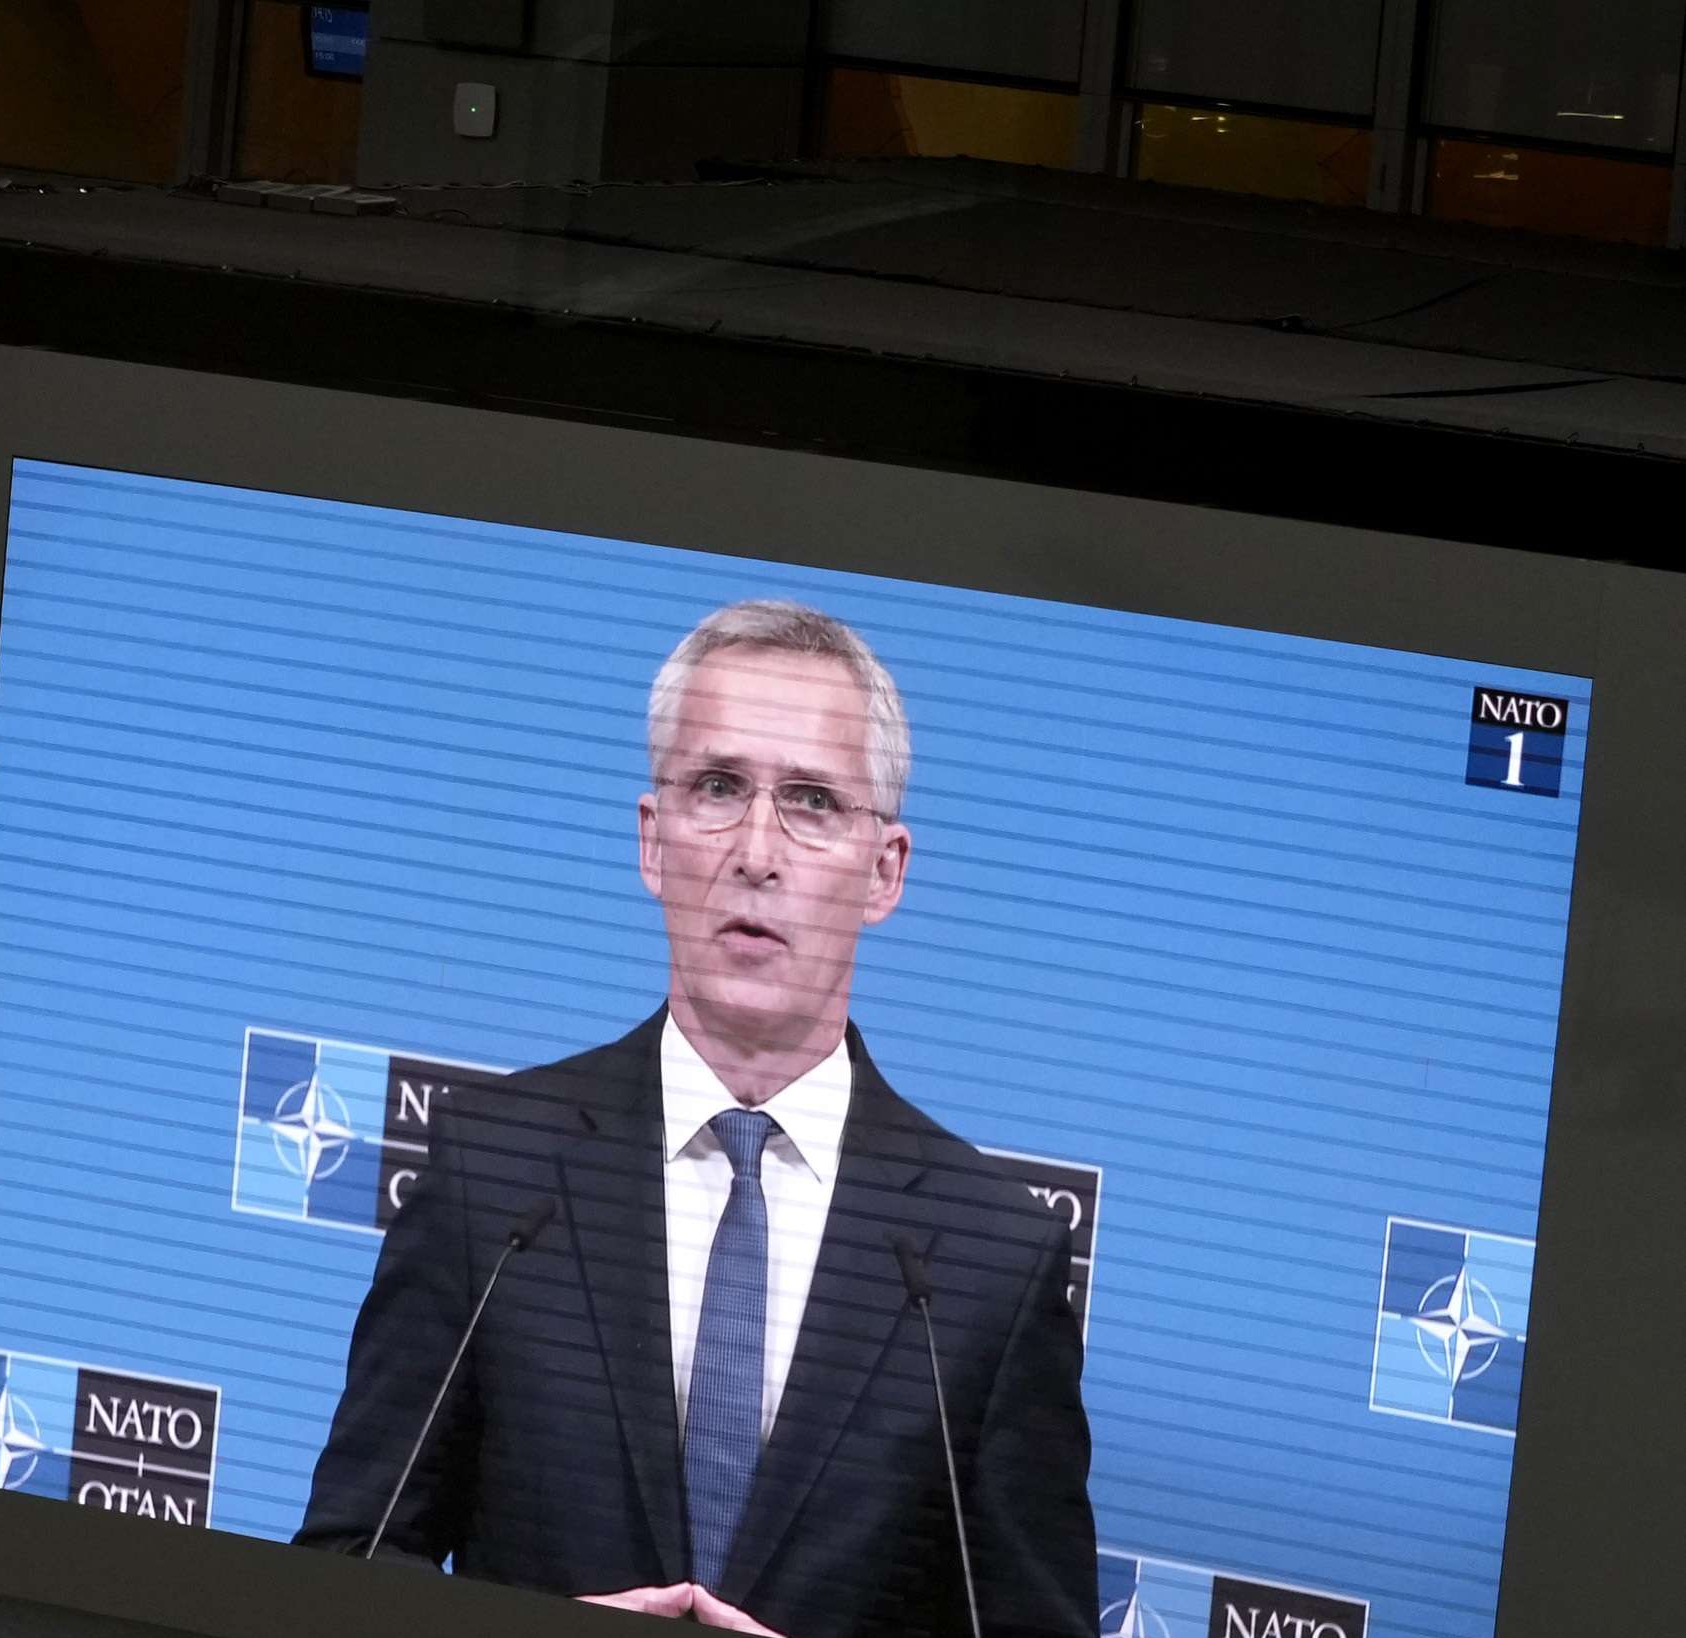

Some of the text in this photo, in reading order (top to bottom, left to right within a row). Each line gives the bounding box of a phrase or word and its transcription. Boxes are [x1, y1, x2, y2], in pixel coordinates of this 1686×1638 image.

[1479, 693, 1563, 729] NATO
[1500, 731, 1525, 786] 1
[85, 1392, 202, 1450] NATO
[78, 1480, 196, 1526] OTAN
